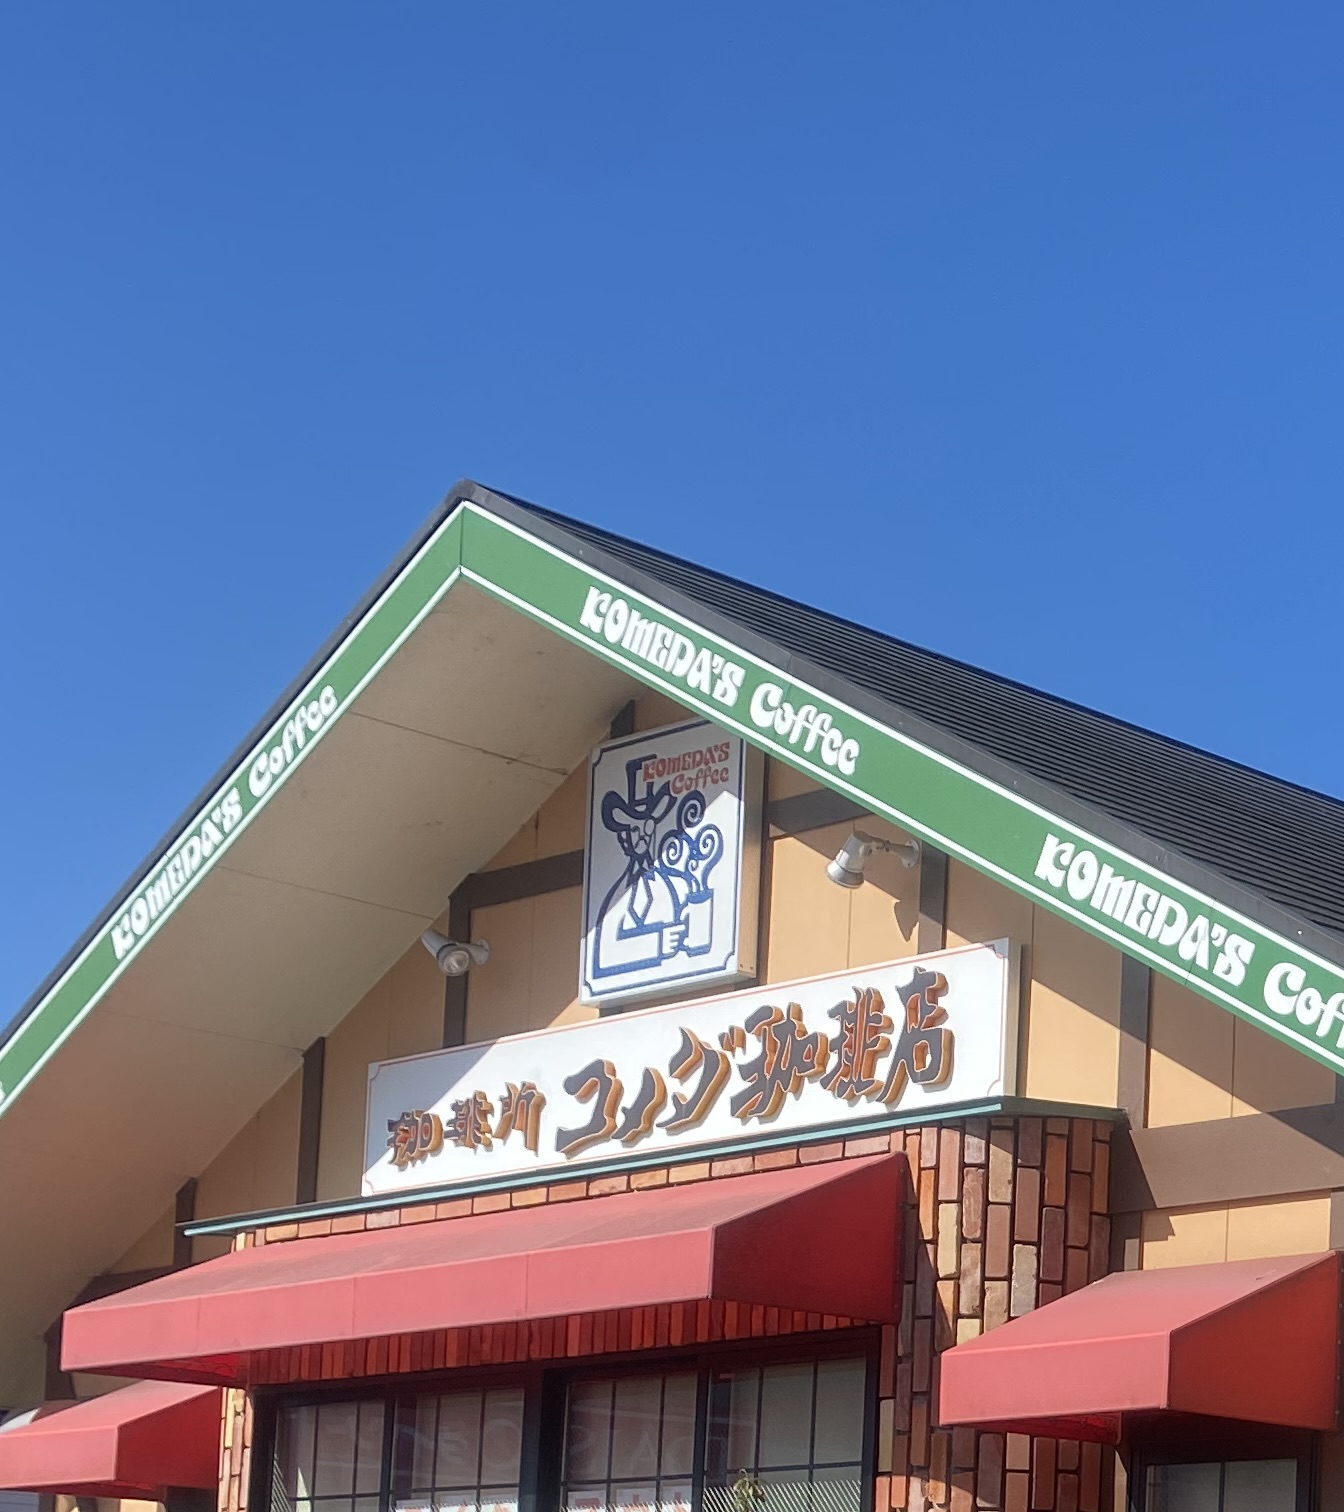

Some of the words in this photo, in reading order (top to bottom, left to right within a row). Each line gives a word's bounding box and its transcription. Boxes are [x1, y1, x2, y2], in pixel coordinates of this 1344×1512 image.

[579, 586, 746, 707] KOMEDA'S
[750, 682, 860, 775] Coffee
[110, 787, 242, 960] KOMEDA'S
[249, 684, 338, 798] Coffee
[643, 741, 730, 782] KOMEDA'S
[671, 765, 729, 794] Coffee
[1034, 833, 1256, 987] KOMEDA'S
